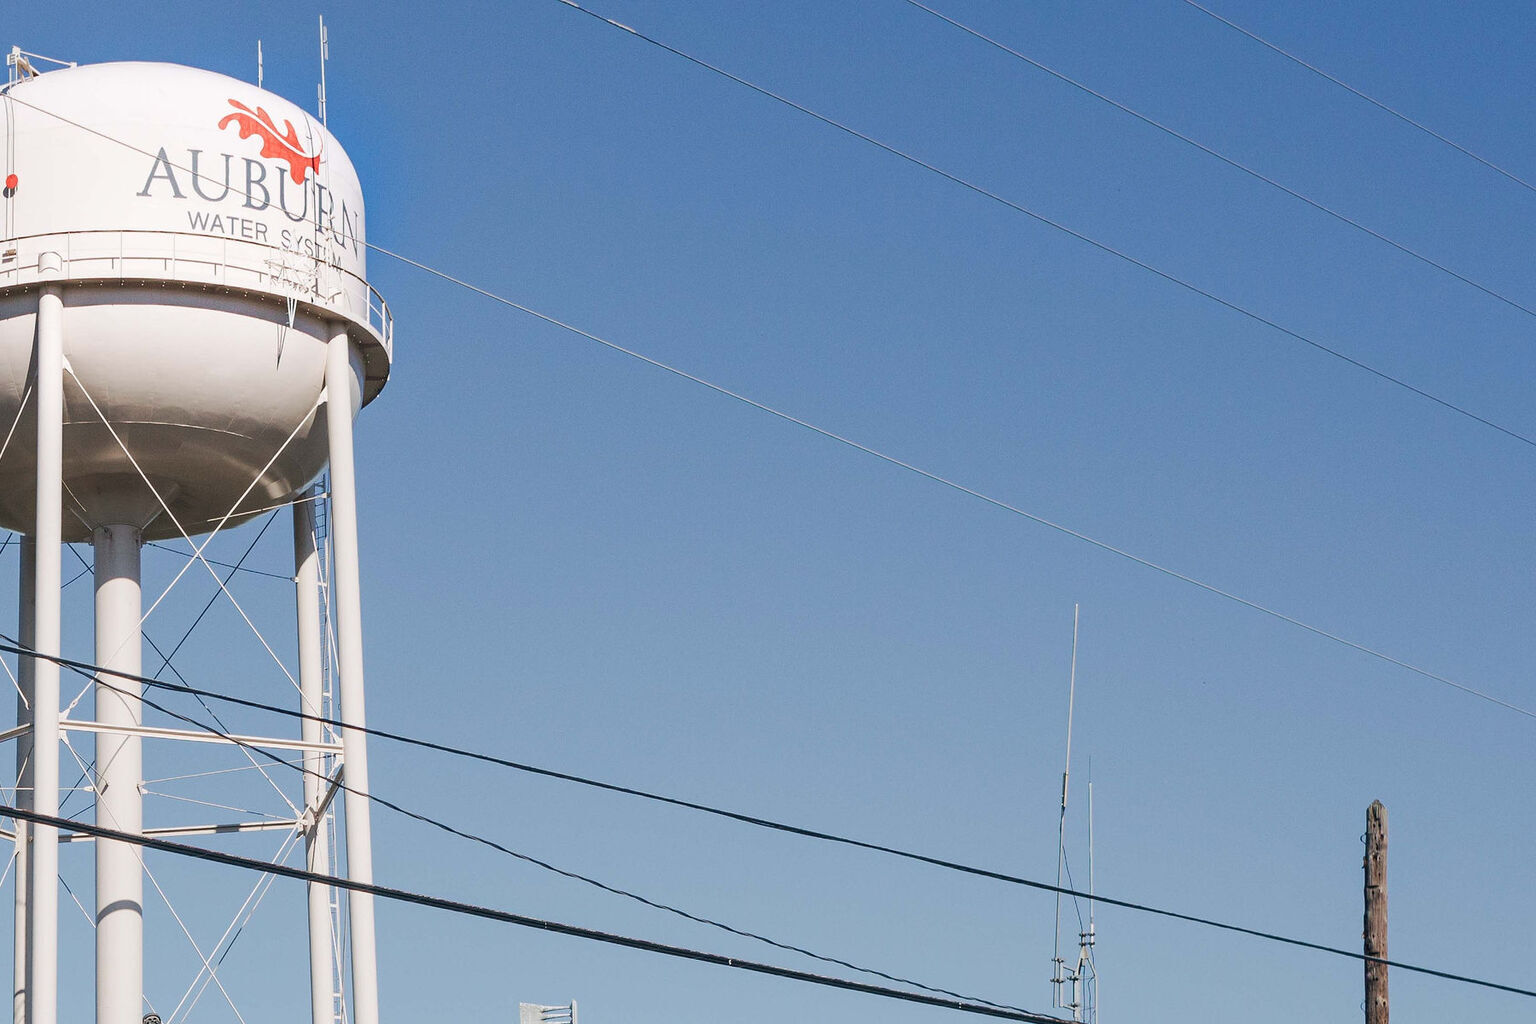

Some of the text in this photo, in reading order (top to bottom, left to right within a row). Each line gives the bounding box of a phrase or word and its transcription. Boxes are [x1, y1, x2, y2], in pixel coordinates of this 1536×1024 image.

[136, 147, 359, 260] AUBURN
[187, 211, 342, 274] WATER SYSTM
